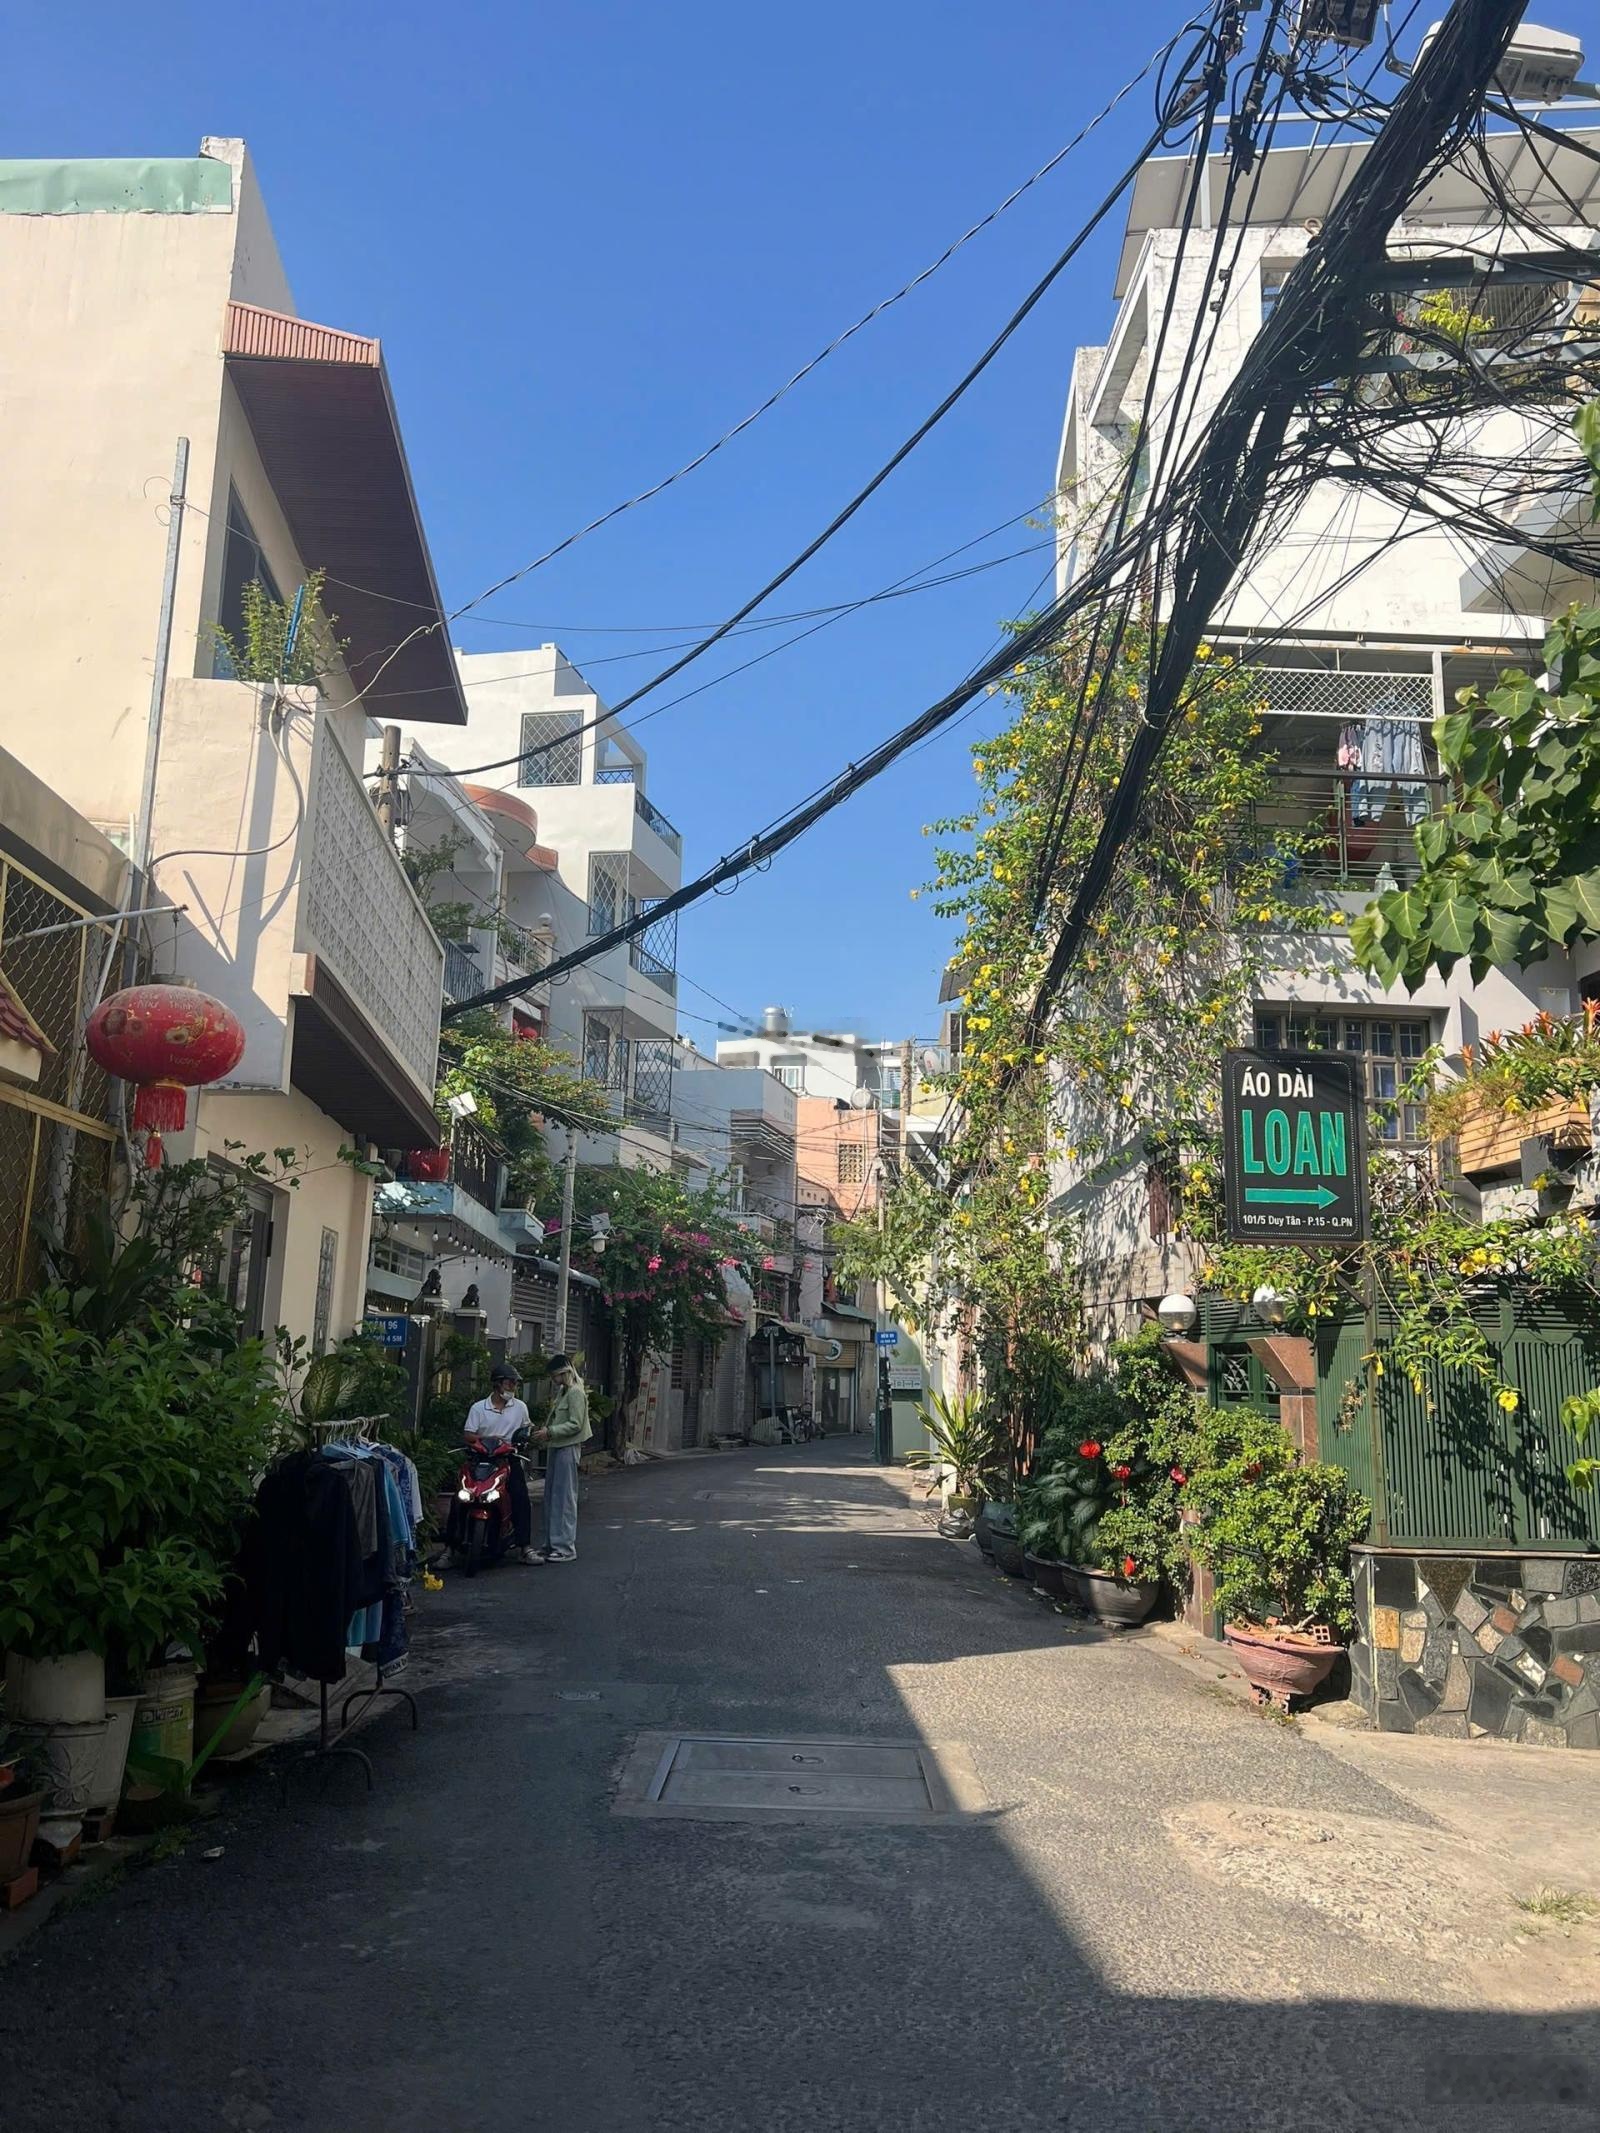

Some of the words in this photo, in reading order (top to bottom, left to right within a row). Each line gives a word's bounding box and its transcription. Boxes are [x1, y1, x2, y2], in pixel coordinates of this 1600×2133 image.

[1241, 1066, 1271, 1097] ÁO
[1278, 1067, 1314, 1098] DÀI
[1241, 1109, 1347, 1176] LOAN
[1242, 1214, 1266, 1224] 101/5
[1268, 1215, 1284, 1227] Duy
[1307, 1216, 1326, 1226] P.15
[1331, 1216, 1353, 1227] Q.PN
